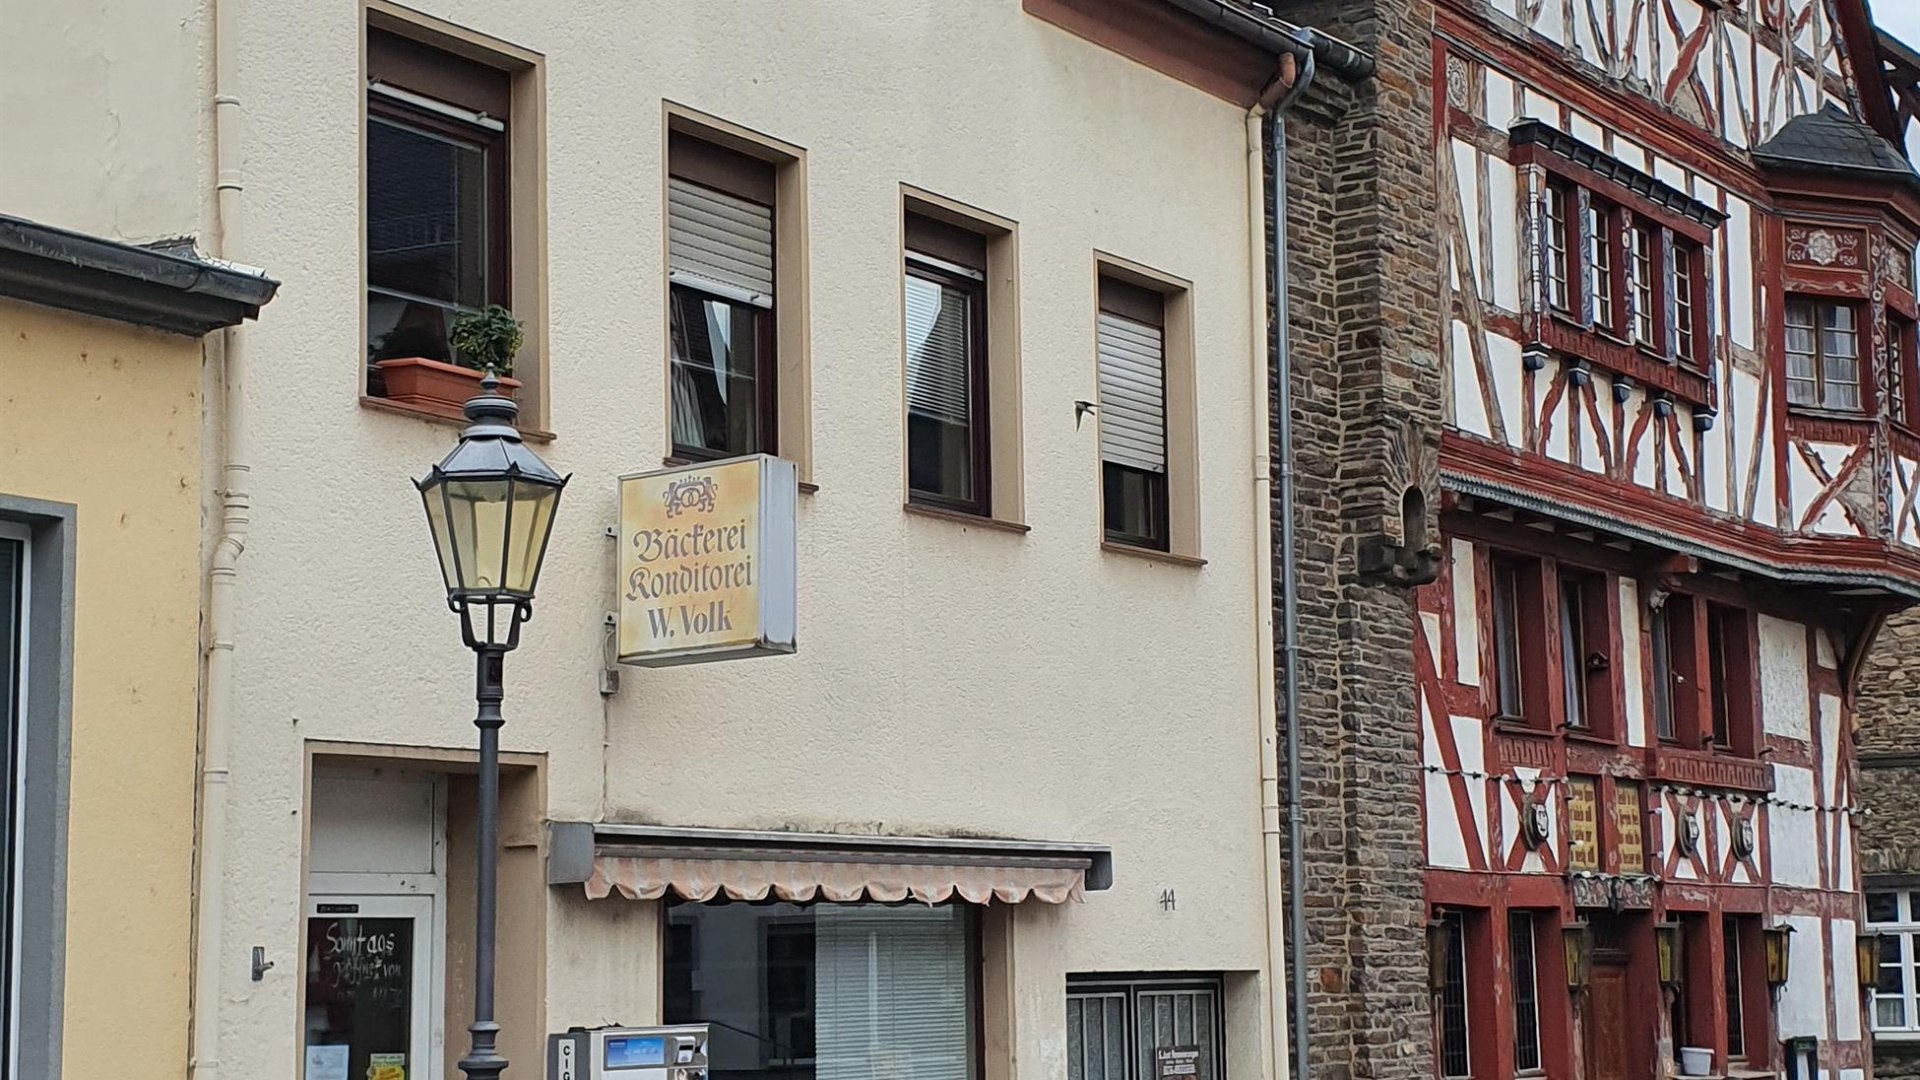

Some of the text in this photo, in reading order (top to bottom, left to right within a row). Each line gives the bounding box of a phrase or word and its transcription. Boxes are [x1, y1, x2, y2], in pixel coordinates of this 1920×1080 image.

[633, 519, 746, 562] Bäckerei
[625, 555, 752, 601] Konditorei
[648, 600, 733, 639] W. Volk
